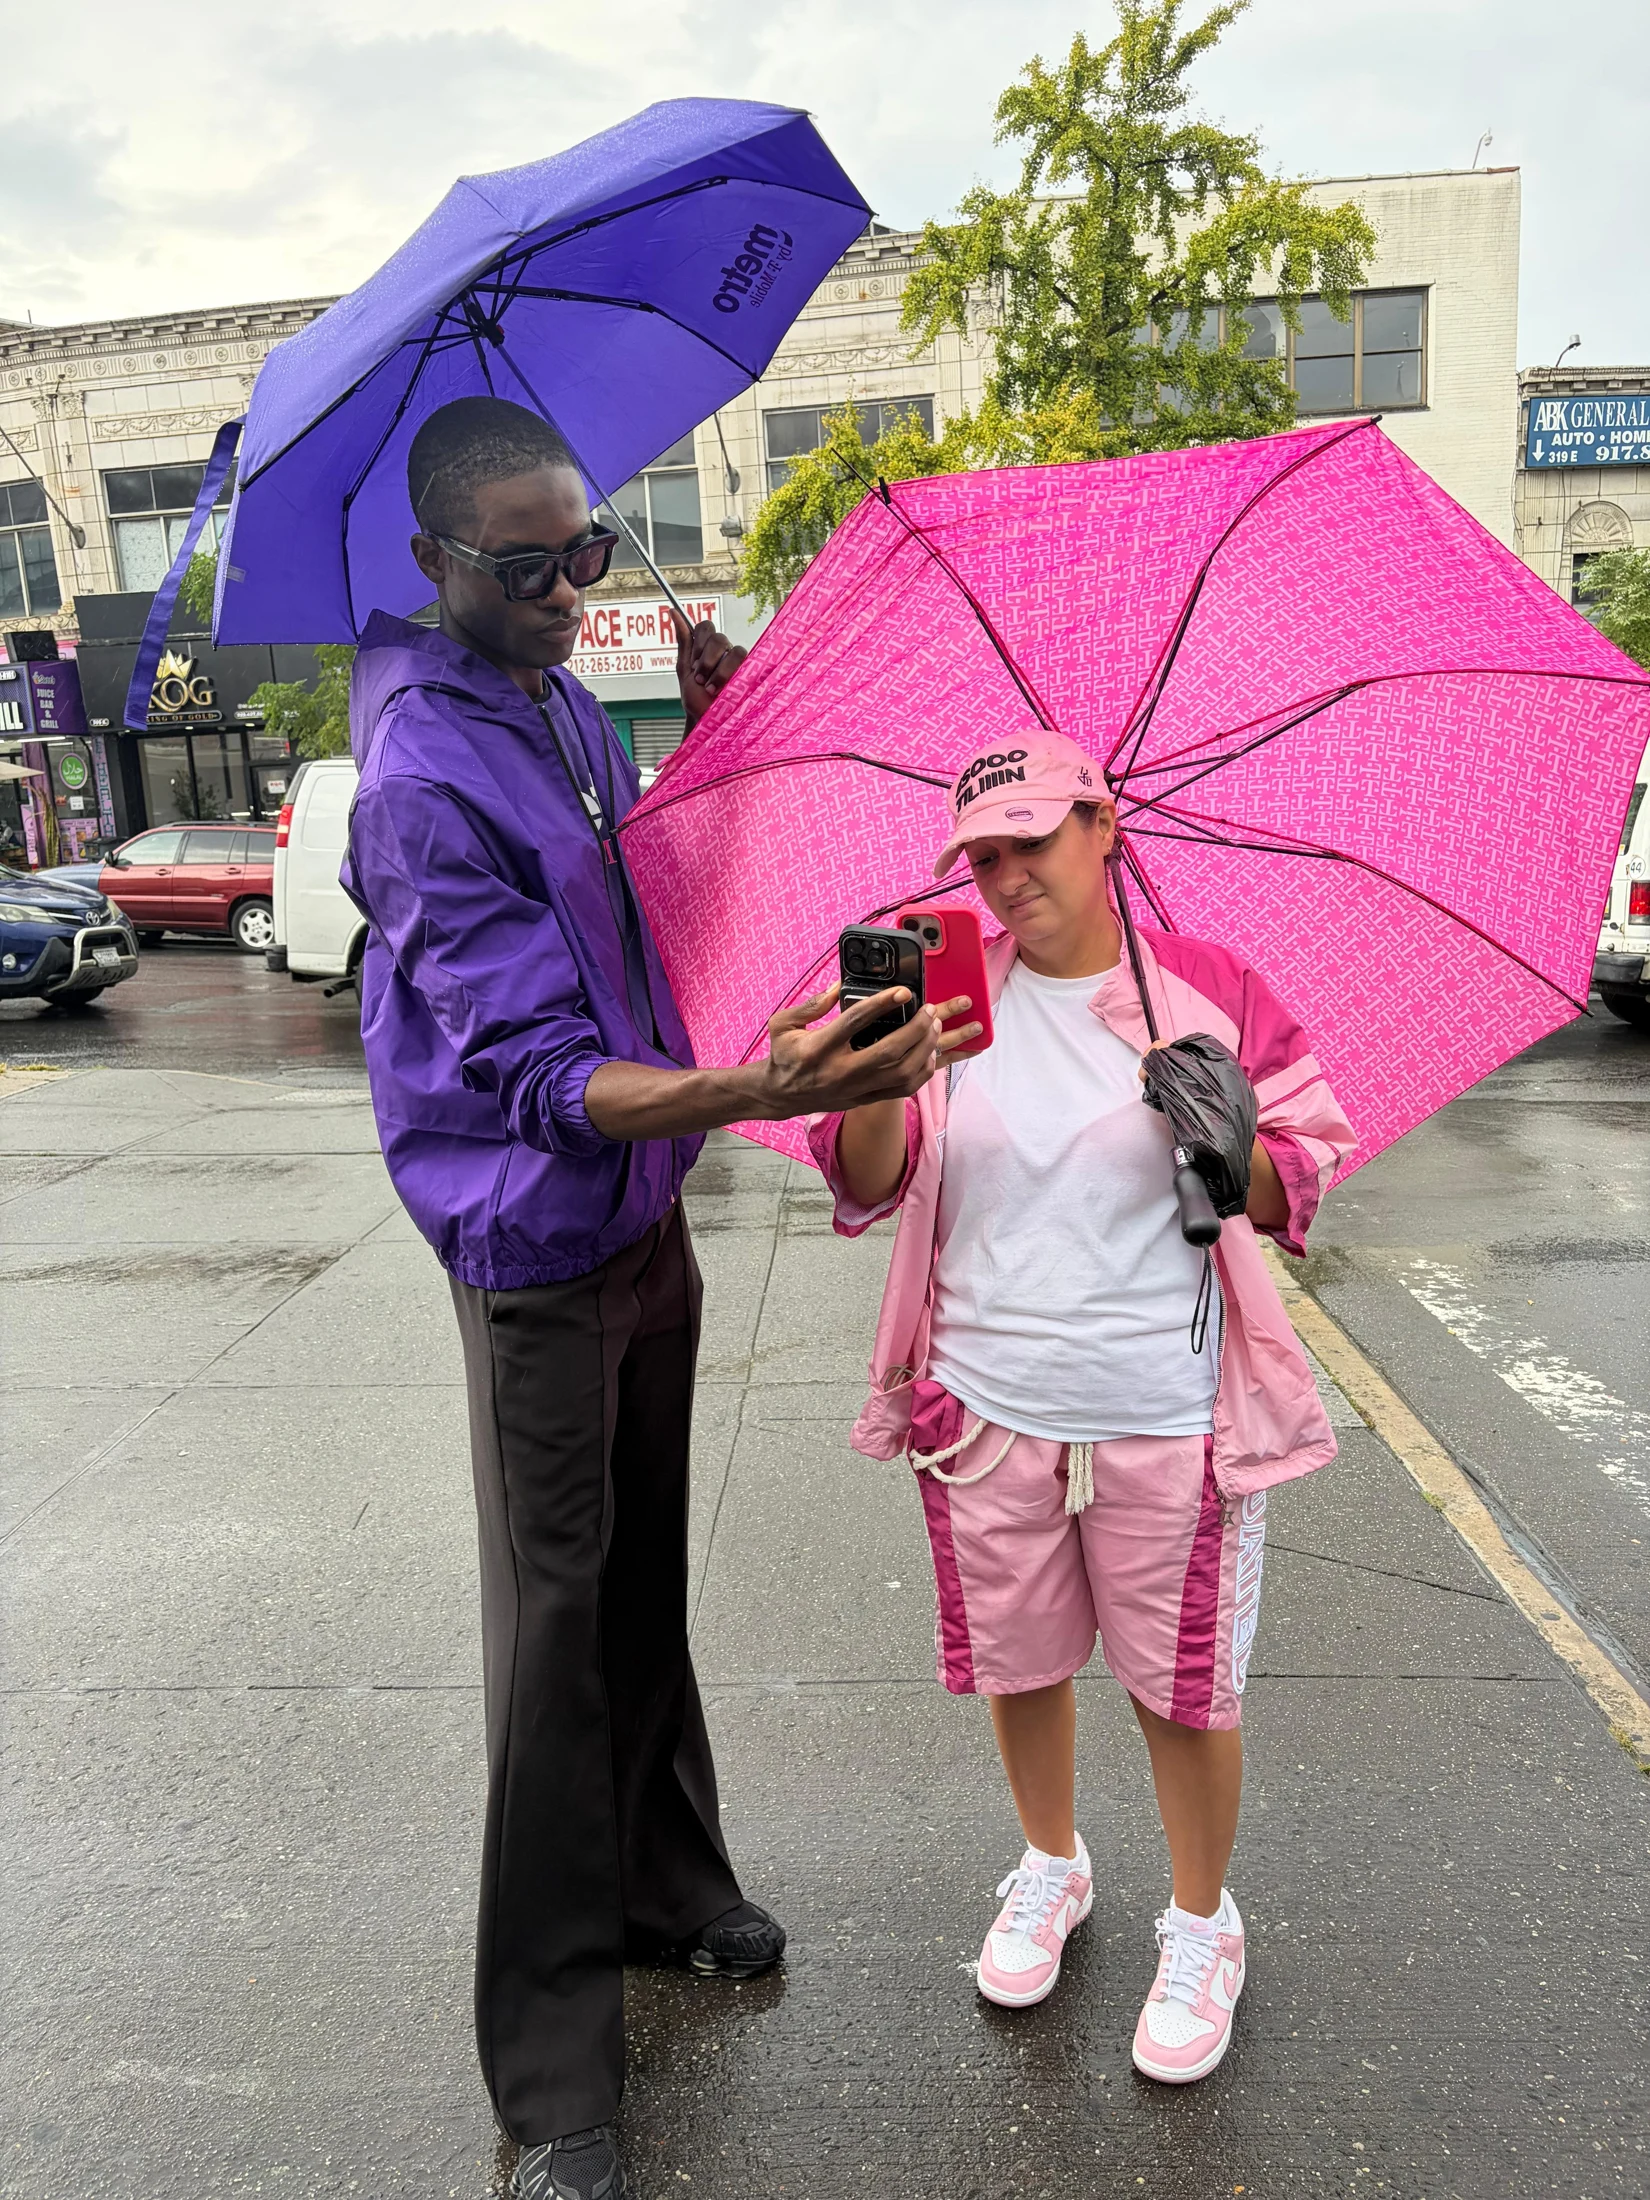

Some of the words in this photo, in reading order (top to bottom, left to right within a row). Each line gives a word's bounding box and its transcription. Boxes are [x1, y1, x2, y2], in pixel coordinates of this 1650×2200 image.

[1534, 401, 1570, 431] ABK
[1571, 401, 1650, 428] GENERAL
[1551, 431, 1595, 446] AUTO
[1549, 451, 1568, 463] 319
[1571, 450, 1578, 462] E
[627, 615, 656, 637] FOR
[37, 689, 55, 698] JUICE
[40, 700, 54, 709] BAR
[188, 713, 214, 721] GOLD
[40, 720, 59, 729] GRILL
